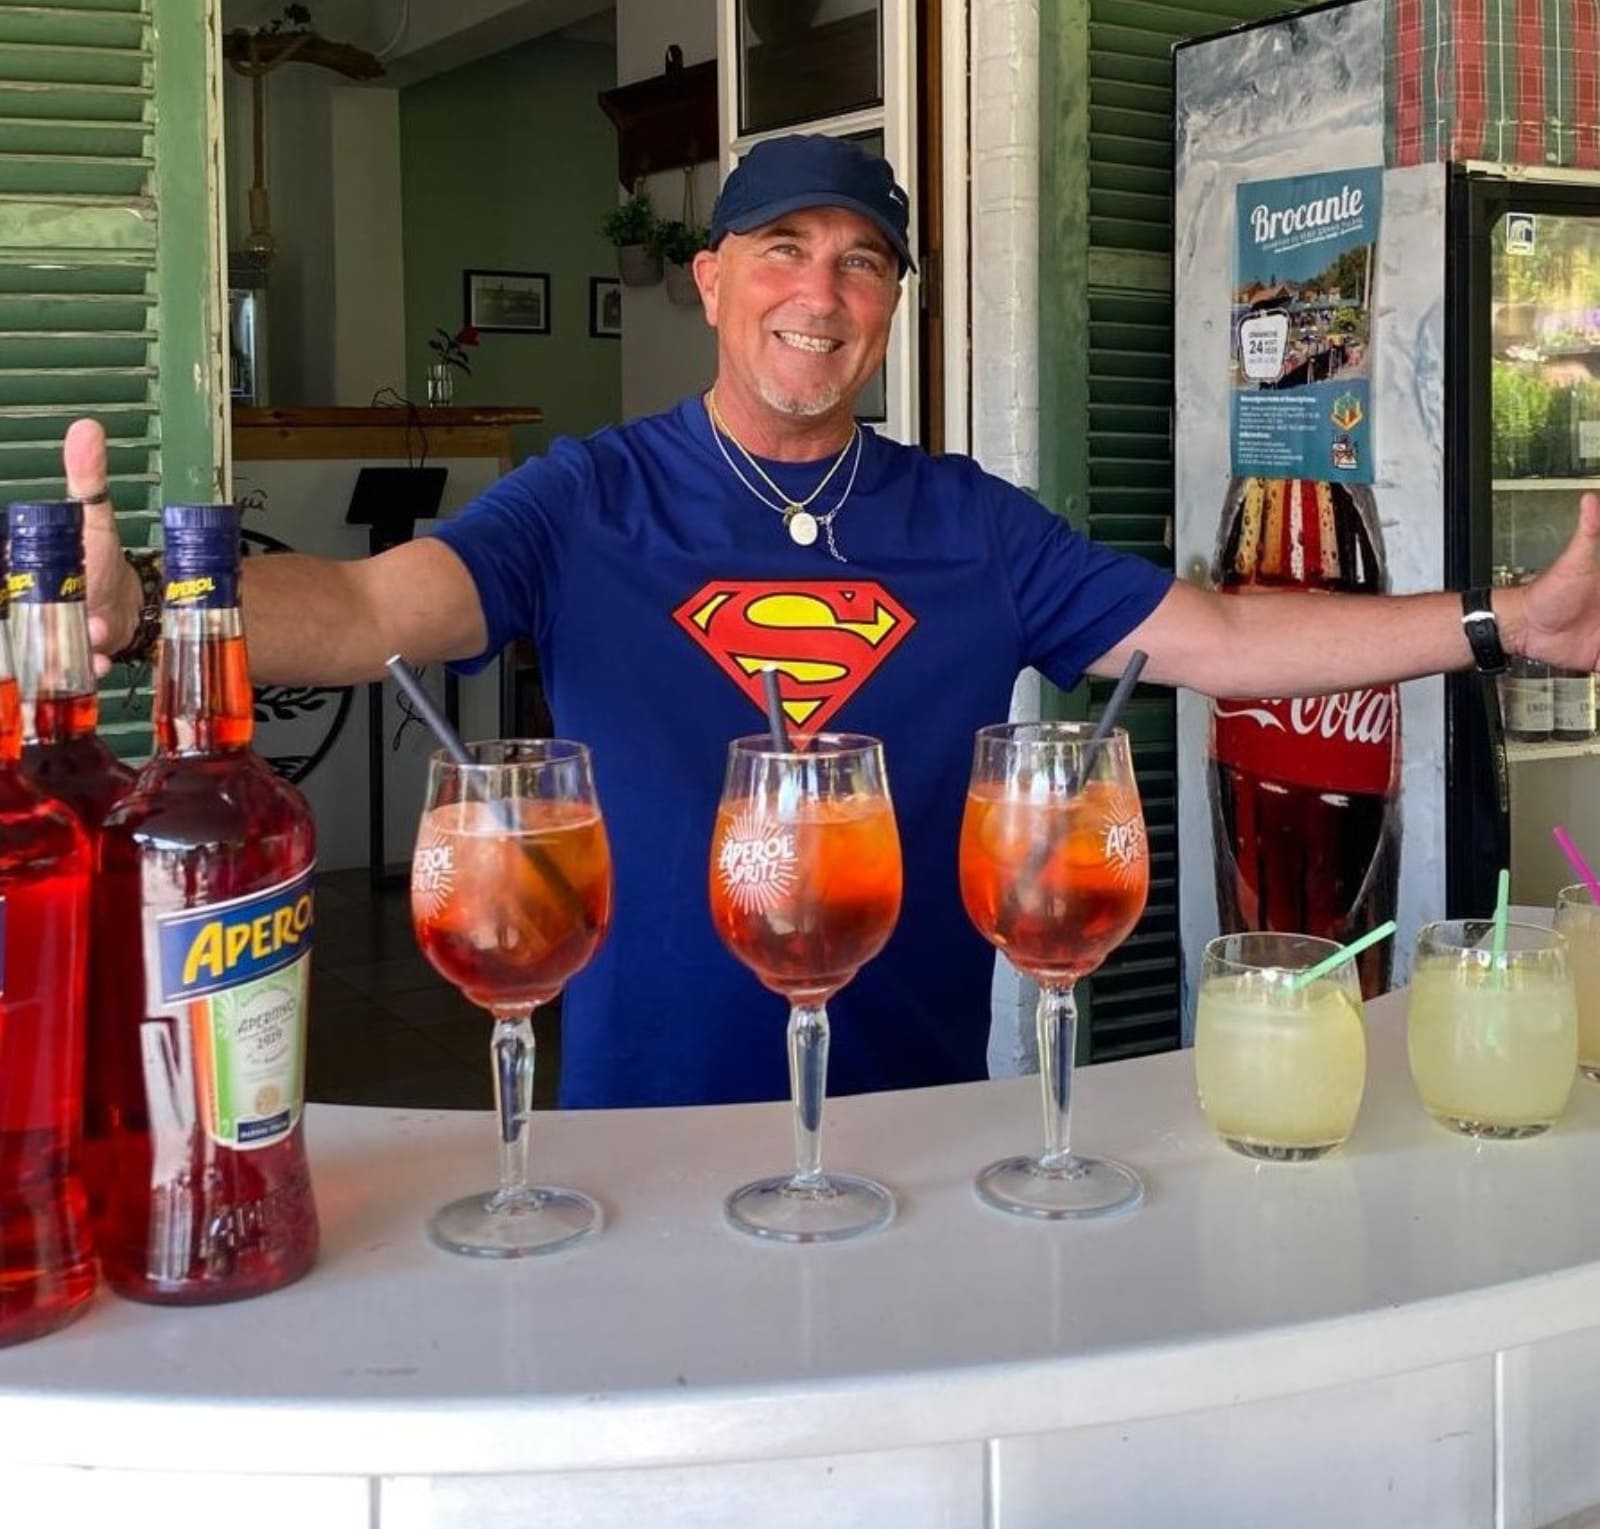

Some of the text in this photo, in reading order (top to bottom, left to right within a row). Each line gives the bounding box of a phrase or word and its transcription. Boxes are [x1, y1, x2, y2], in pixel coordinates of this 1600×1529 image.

[1251, 185, 1365, 244] Brocante
[1249, 340, 1264, 355] 24
[166, 577, 216, 601] APEROL
[1291, 684, 1392, 743] Cola
[719, 835, 795, 870] APEROL
[182, 895, 313, 985] APERO
